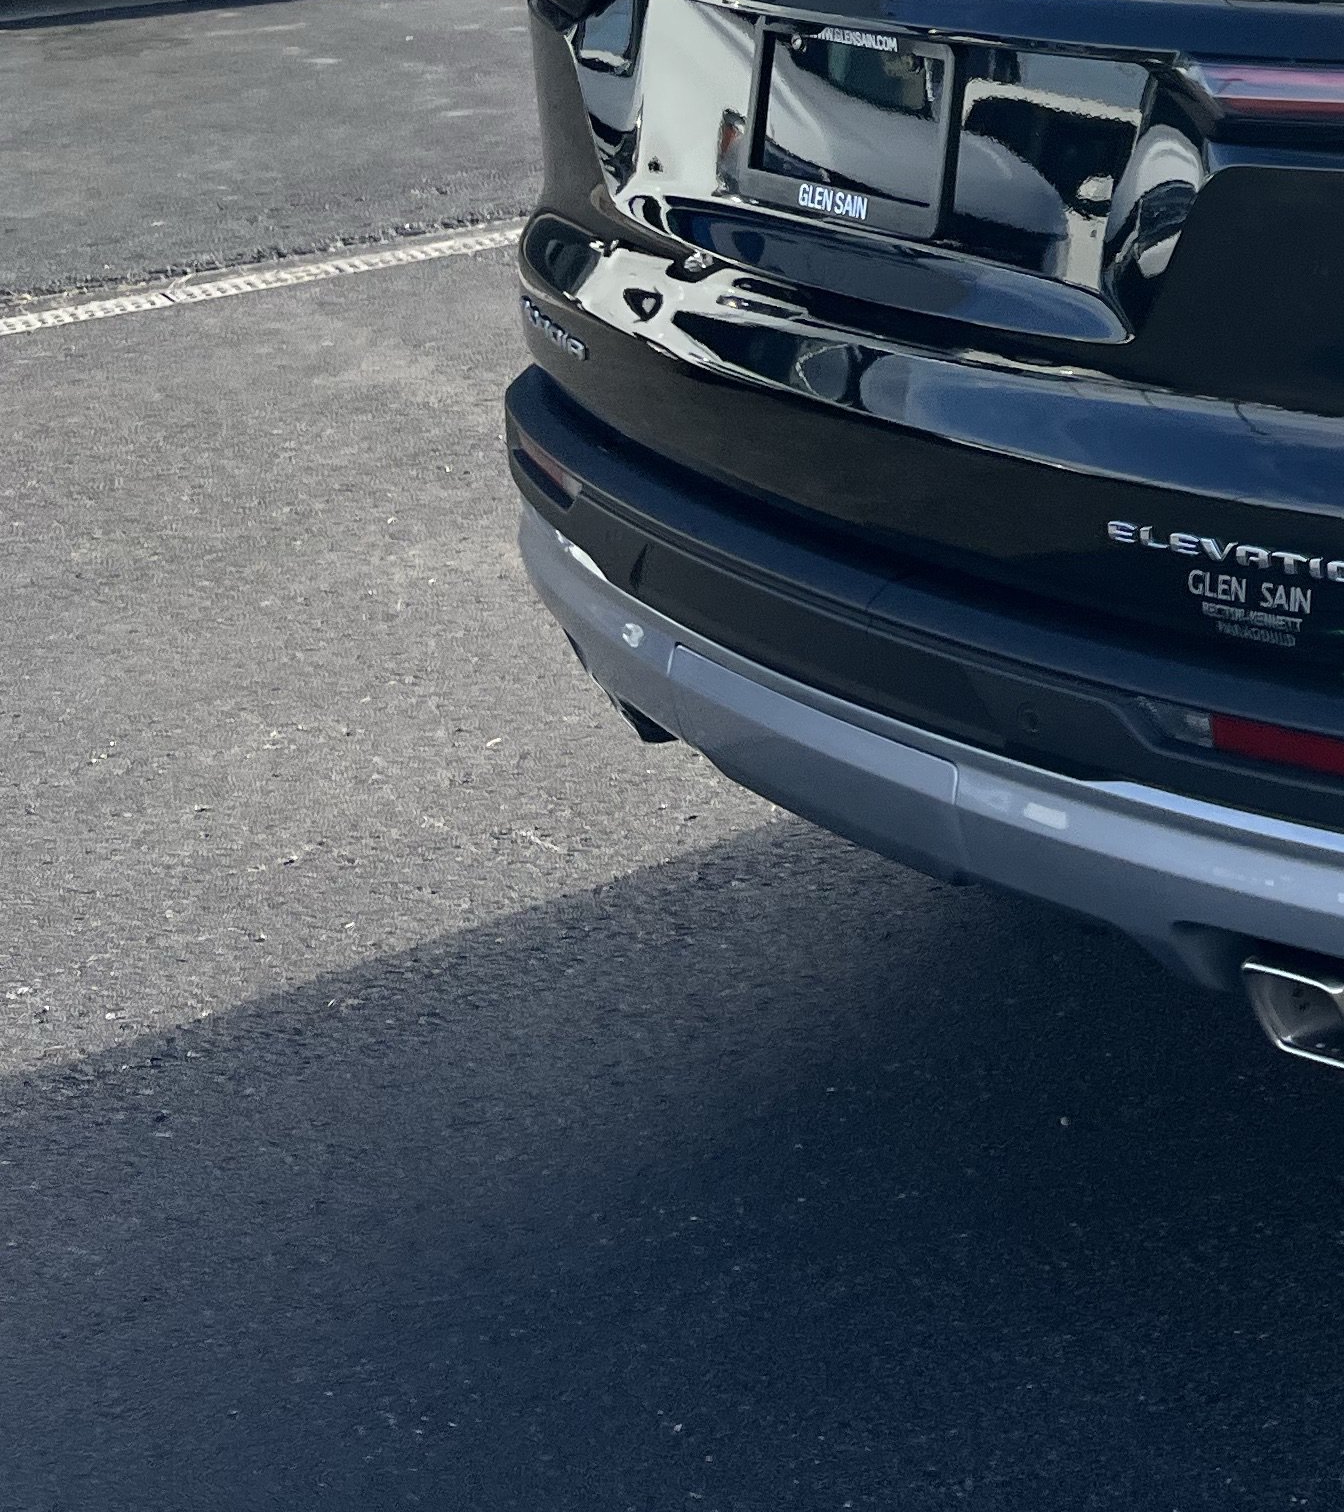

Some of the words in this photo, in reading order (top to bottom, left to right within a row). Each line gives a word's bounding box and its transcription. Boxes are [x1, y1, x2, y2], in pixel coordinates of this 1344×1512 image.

[798, 183, 834, 213] GLEN
[834, 191, 869, 220] SAIN
[1187, 569, 1247, 603] GLEN
[1260, 582, 1312, 614] SAIN
